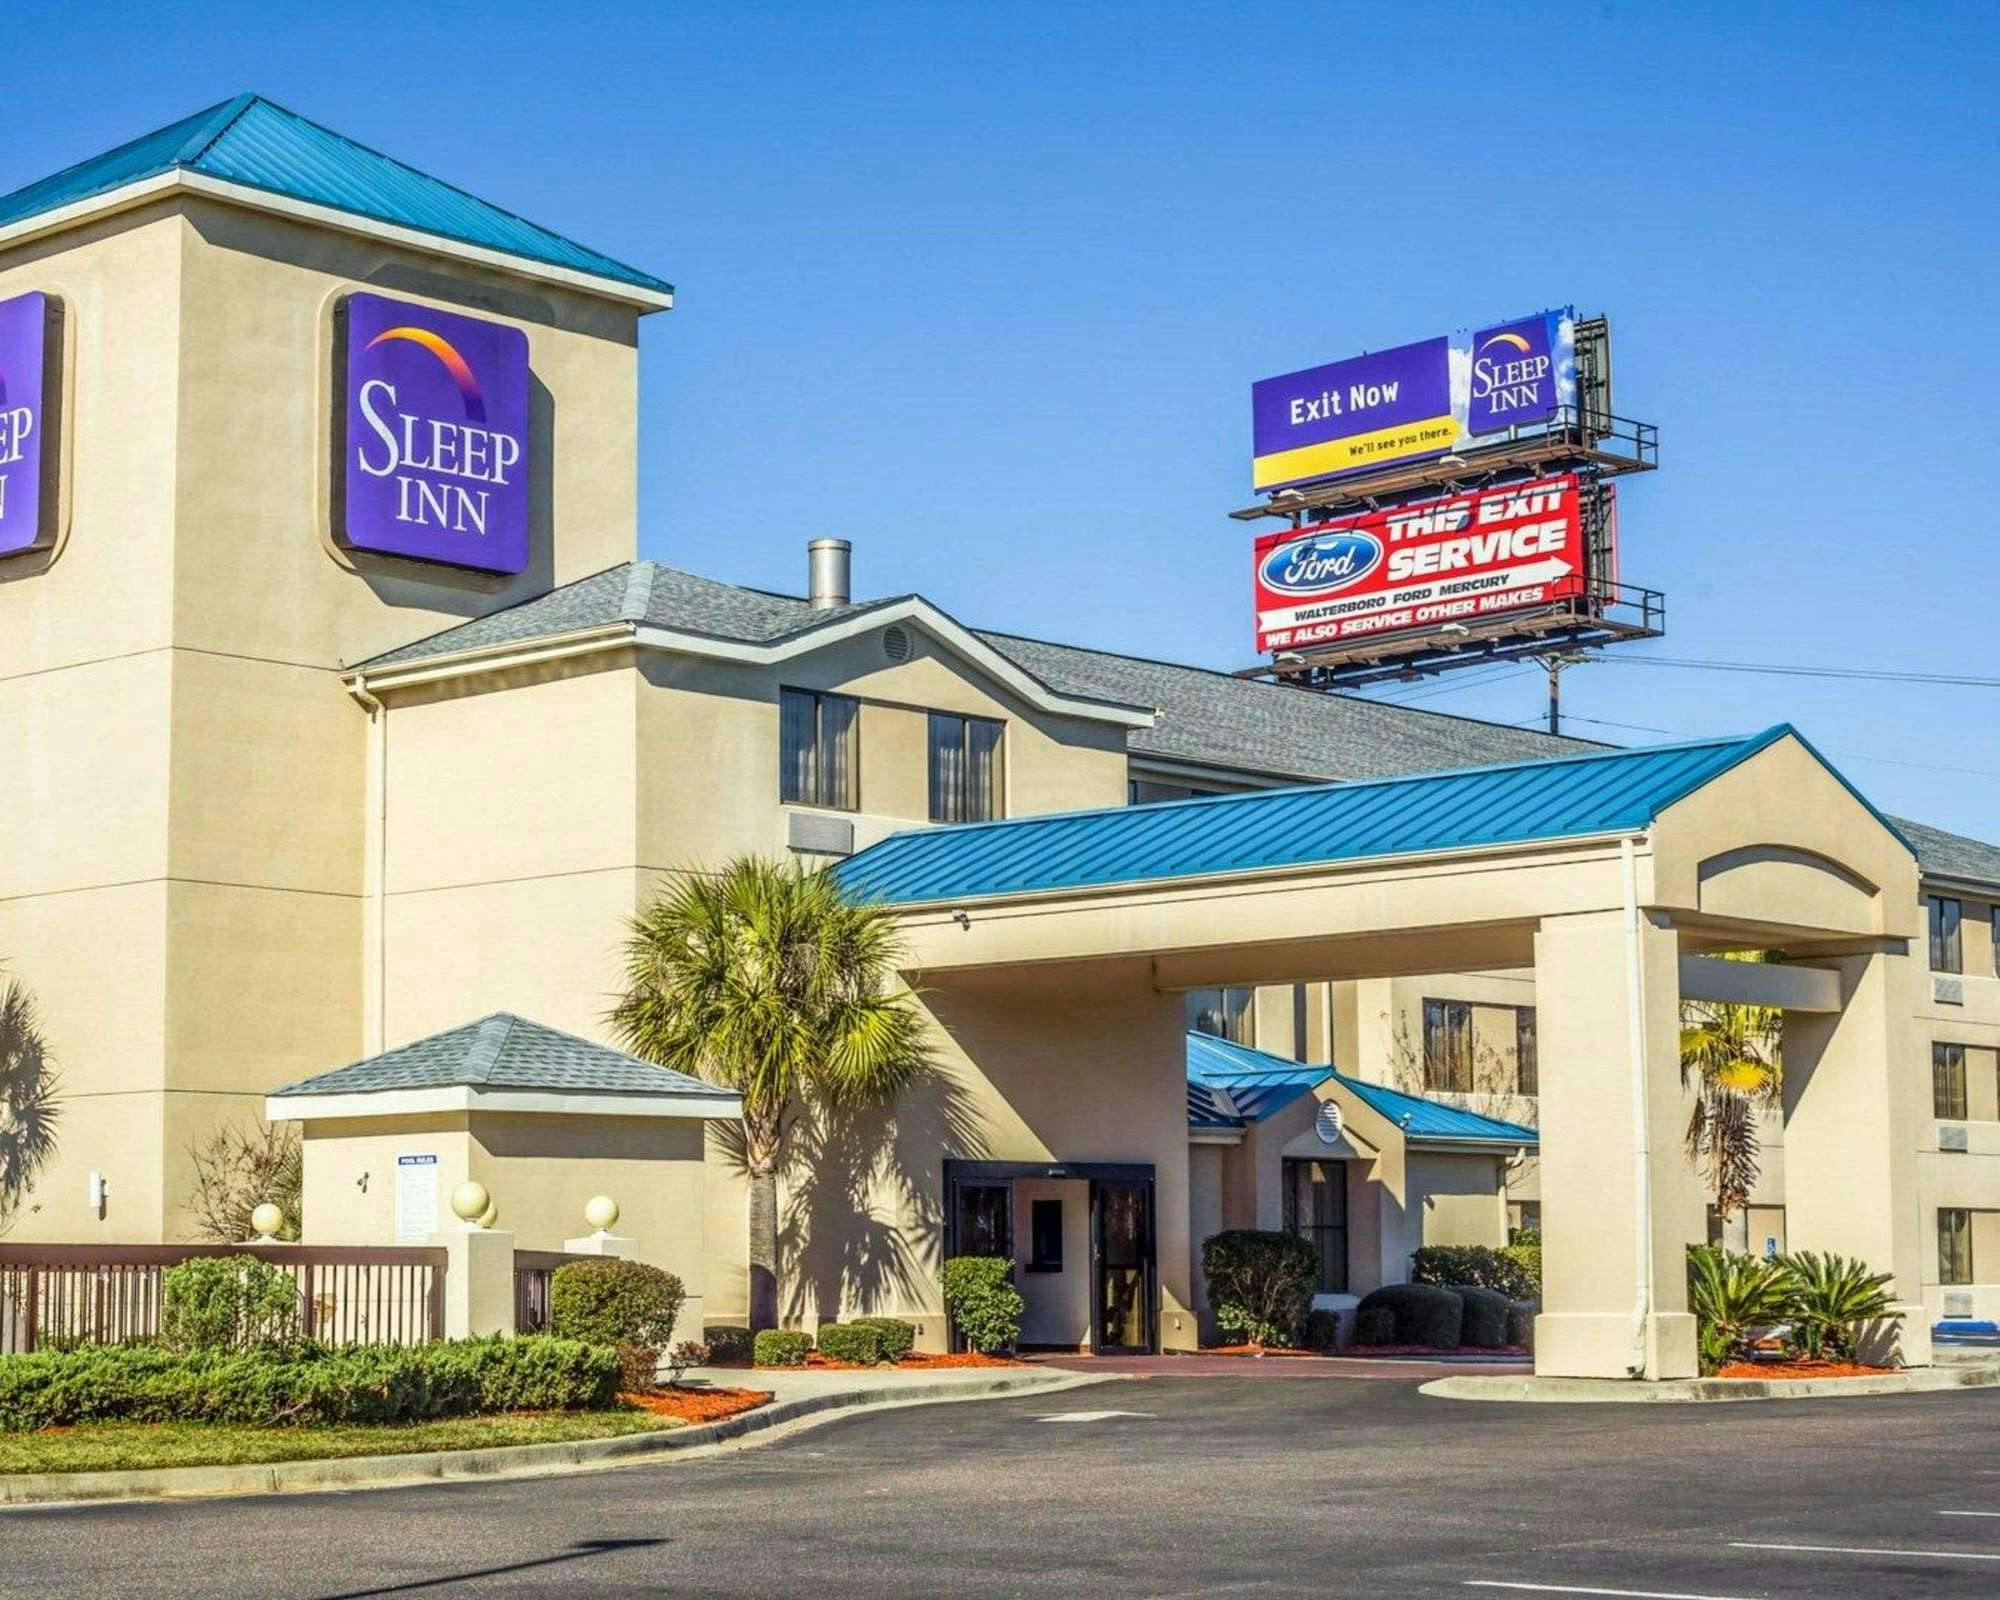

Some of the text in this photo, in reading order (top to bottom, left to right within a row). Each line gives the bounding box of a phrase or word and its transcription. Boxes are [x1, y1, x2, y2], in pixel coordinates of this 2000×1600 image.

[1472, 355, 1549, 398] SLEEP
[1489, 382, 1539, 414] INN
[1290, 381, 1399, 425] Exit Now
[358, 379, 520, 485] SLEEP
[1349, 427, 1452, 456] We'll see you there.
[396, 476, 489, 536] INN
[1386, 480, 1568, 542] THIS EXIT
[1284, 541, 1356, 584] Ford
[1386, 518, 1568, 582] SERVICE
[1264, 587, 1544, 647] WE ALSO SERVICE OTHER MAKES
[1295, 574, 1510, 622] WALTERBORO FORD MERCURY
